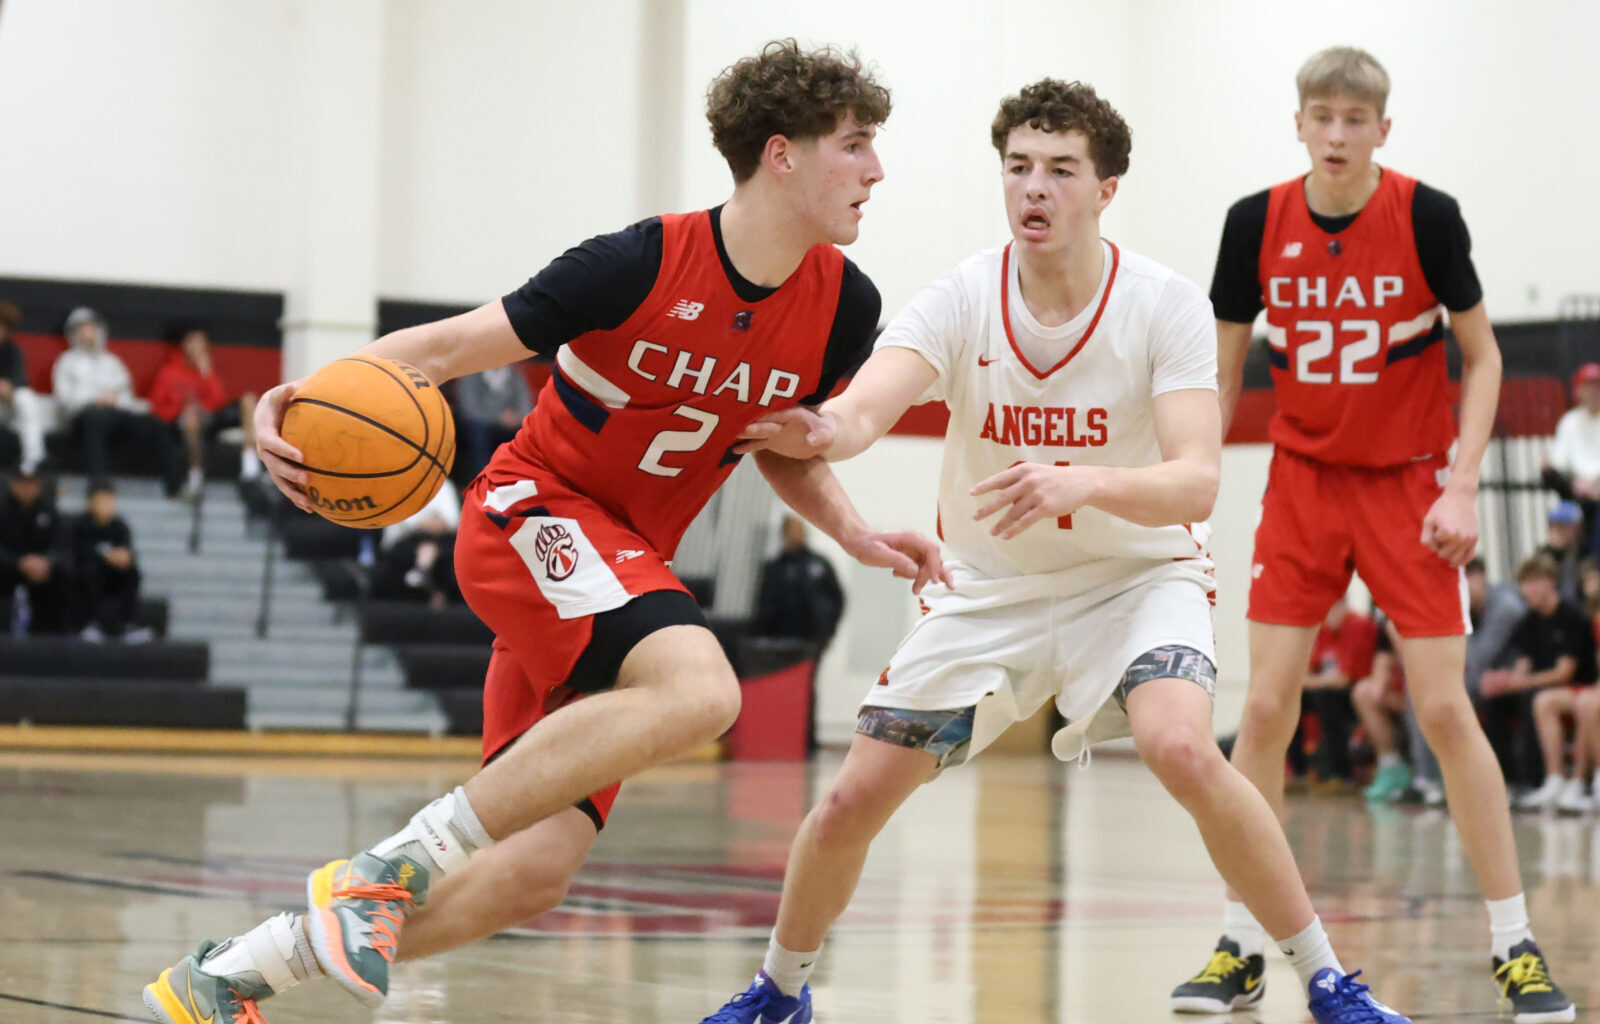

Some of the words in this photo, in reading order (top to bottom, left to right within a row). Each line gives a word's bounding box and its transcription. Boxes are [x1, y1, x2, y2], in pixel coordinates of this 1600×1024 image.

[1269, 275, 1404, 308] CHAP
[627, 339, 800, 407] CHAP
[1295, 319, 1381, 384] 22
[637, 404, 720, 478] 2
[979, 402, 1108, 447] ANGELS
[309, 486, 378, 511] lson
